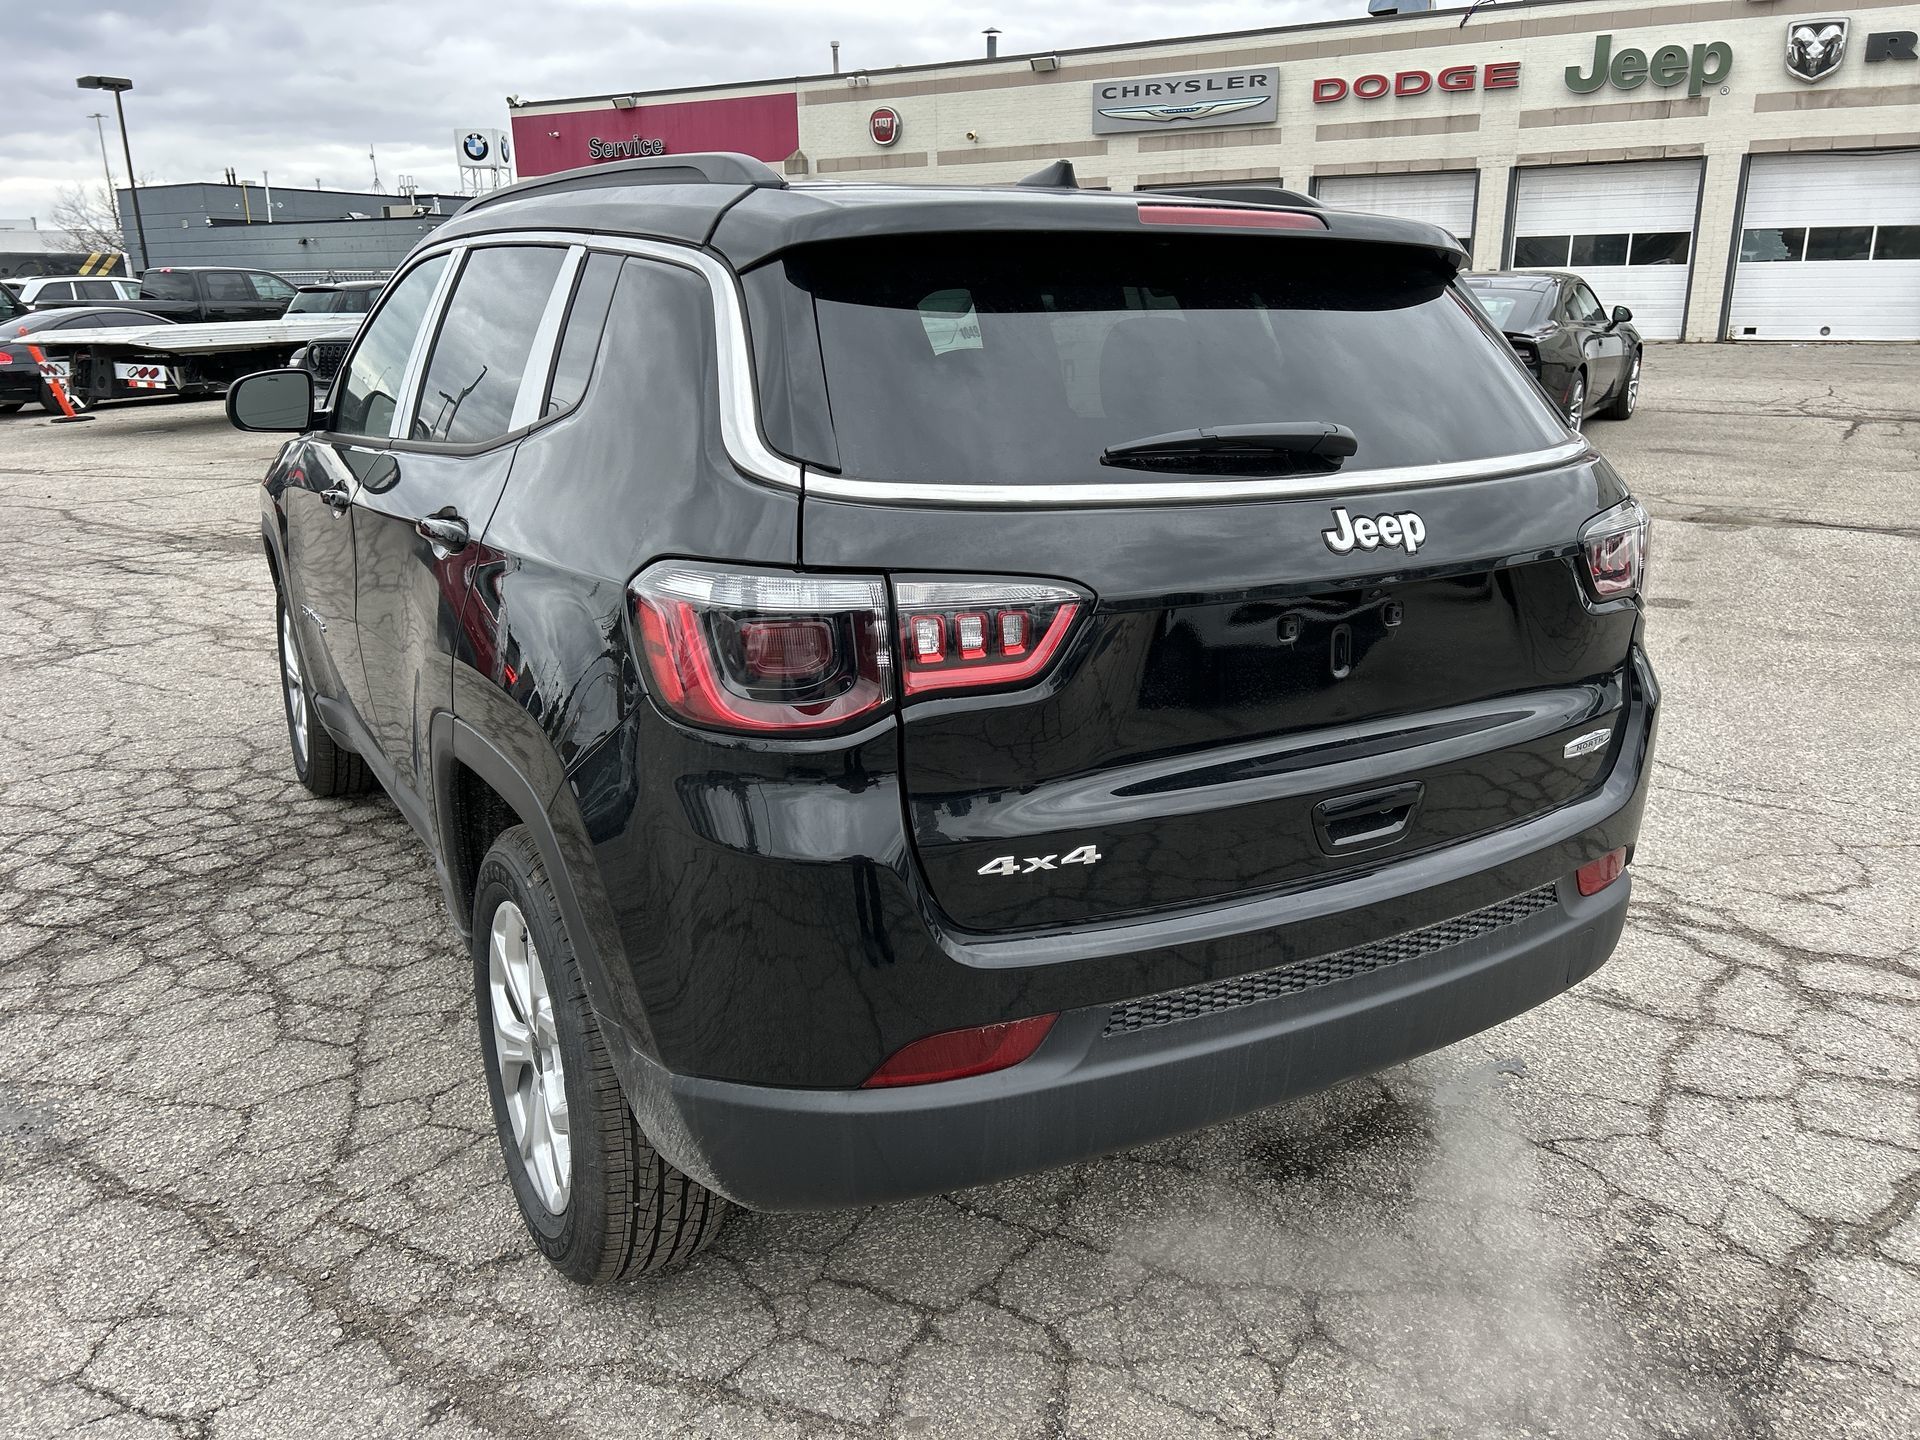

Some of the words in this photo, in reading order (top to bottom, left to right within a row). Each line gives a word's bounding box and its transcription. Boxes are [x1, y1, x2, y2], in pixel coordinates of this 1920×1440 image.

[1313, 61, 1521, 104] DODGE
[1565, 34, 1733, 97] Jeep
[1101, 74, 1268, 100] CHRYSLER
[588, 133, 664, 159] Service
[1321, 506, 1426, 556] Jeep
[1576, 735, 1604, 751] NORTH
